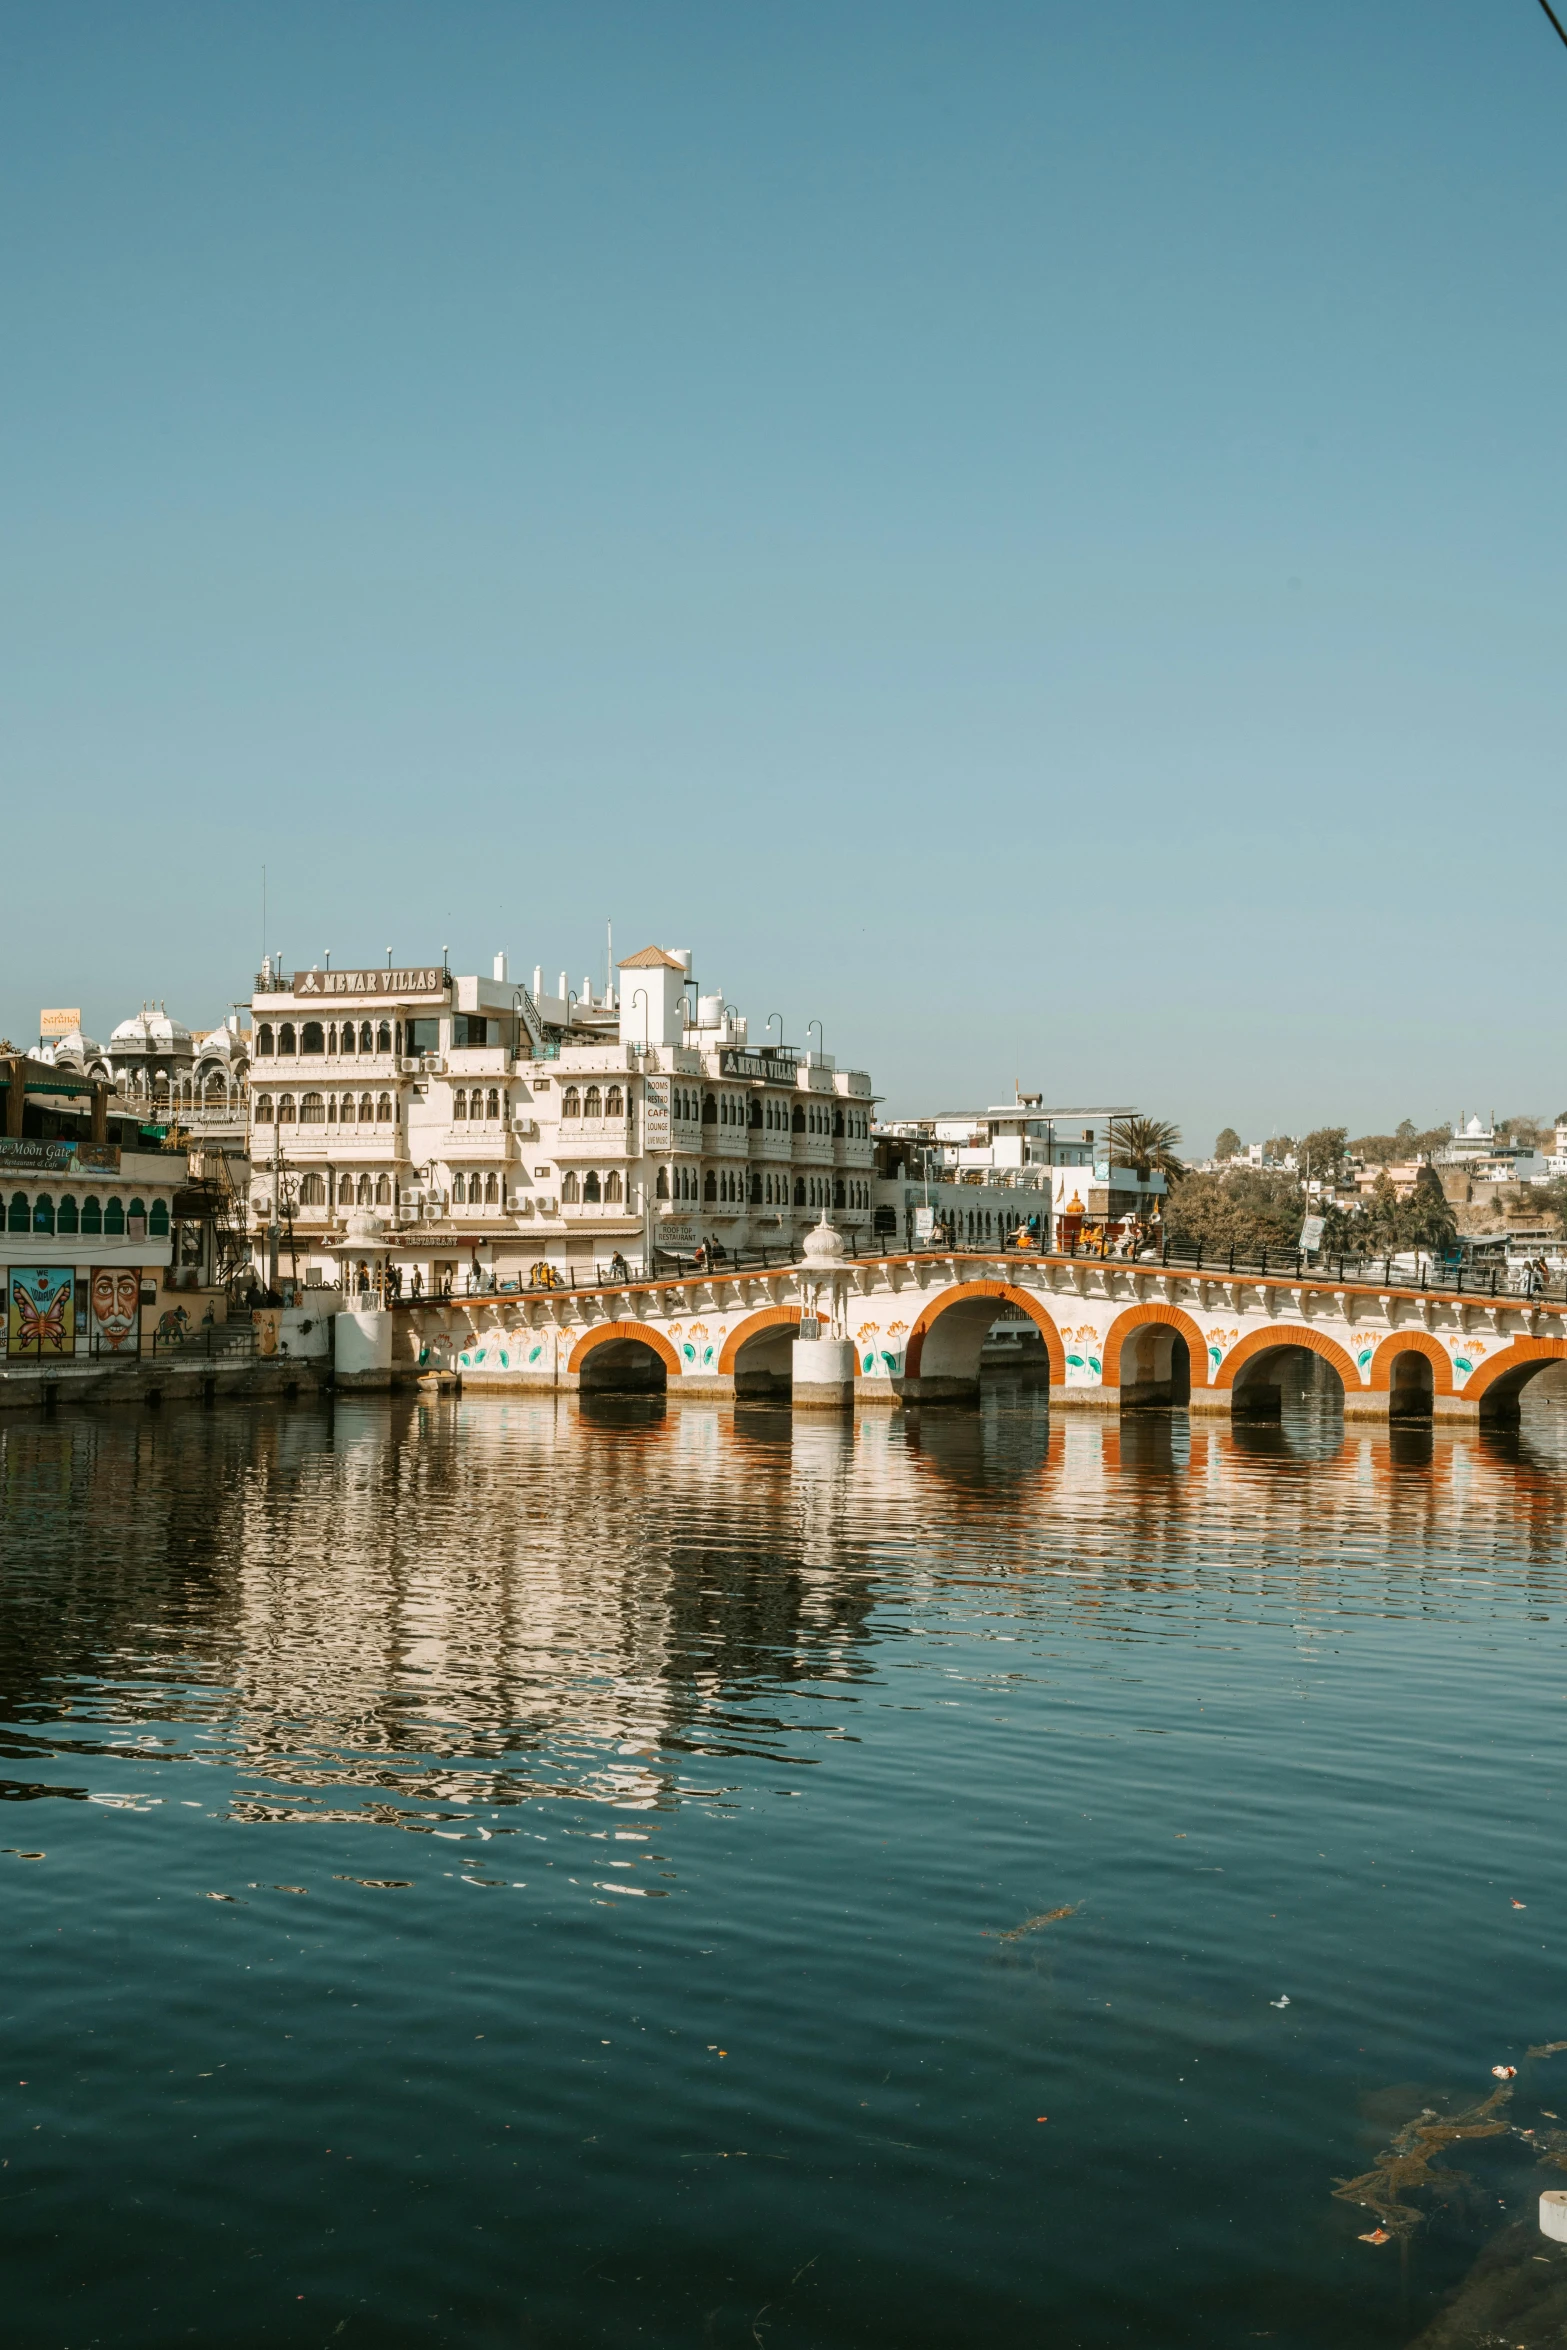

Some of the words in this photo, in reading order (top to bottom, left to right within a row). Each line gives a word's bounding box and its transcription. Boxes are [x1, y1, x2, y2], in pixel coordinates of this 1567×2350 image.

[324, 973, 377, 993] MEWAR
[381, 970, 437, 992] VILLAS
[737, 1056, 768, 1077] MEWAR
[768, 1060, 797, 1081] VILLAS
[647, 1081, 668, 1090] ROOMS
[647, 1095, 668, 1104] RESTRO
[647, 1109, 668, 1118] CAFE
[647, 1122, 668, 1131] LOUNGE
[647, 1136, 655, 1145] LIVE
[656, 1136, 668, 1145] MUSIC
[10, 1142, 42, 1156] Moon
[46, 1144, 71, 1161] Gate
[4, 1158, 36, 1167] Restaurant
[662, 1226, 680, 1234] ROOF
[405, 1236, 458, 1246] RESTAURANT
[658, 1233, 697, 1241] RESTAURANT
[36, 1269, 49, 1277] WE
[30, 1286, 55, 1302] UDAIPUR
